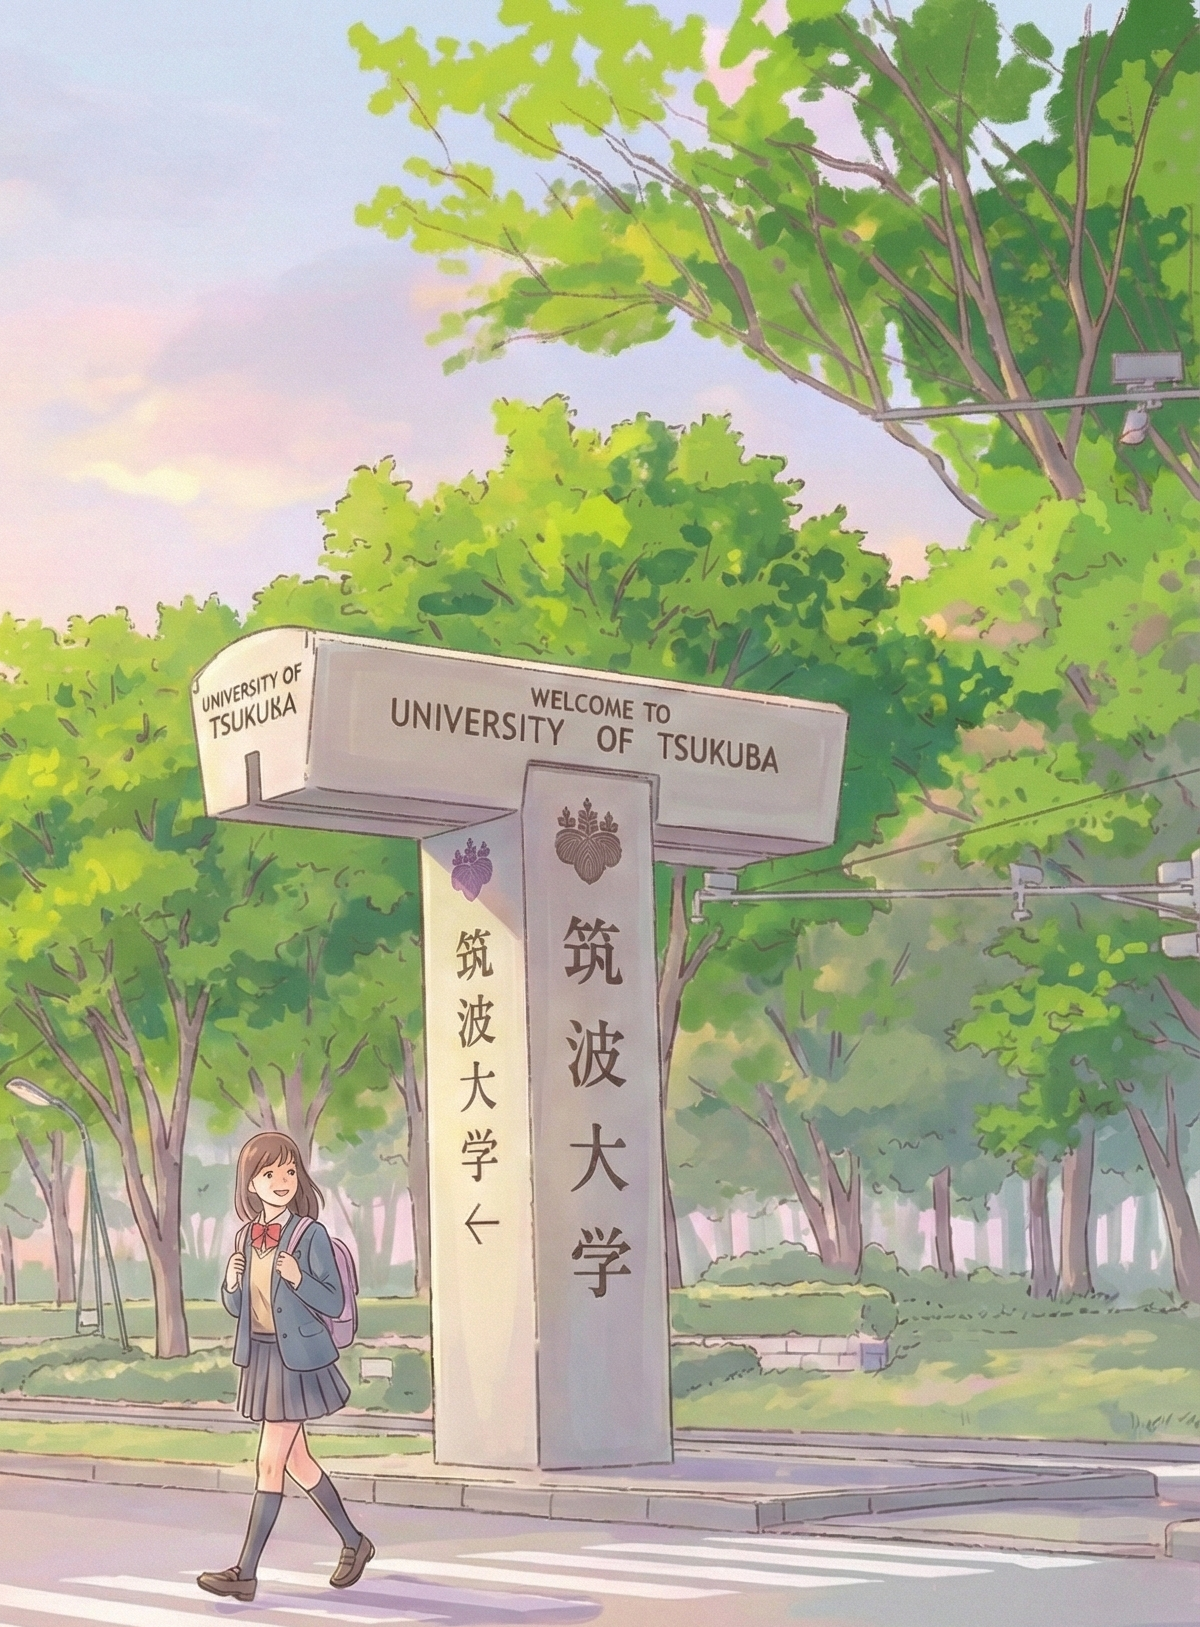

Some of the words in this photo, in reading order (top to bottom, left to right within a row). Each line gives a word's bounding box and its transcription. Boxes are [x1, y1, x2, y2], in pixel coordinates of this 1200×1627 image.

[202, 671, 279, 713] UNIVERSITY
[282, 661, 302, 685] OF
[530, 686, 635, 721] WELCOME
[642, 701, 672, 725] TO
[391, 697, 566, 747] UNIVERSITY
[596, 725, 634, 754] OF
[657, 732, 780, 775] TSUKUBA
[455, 928, 498, 1182] 筑波大学
[562, 915, 632, 1299] 筑波大学
